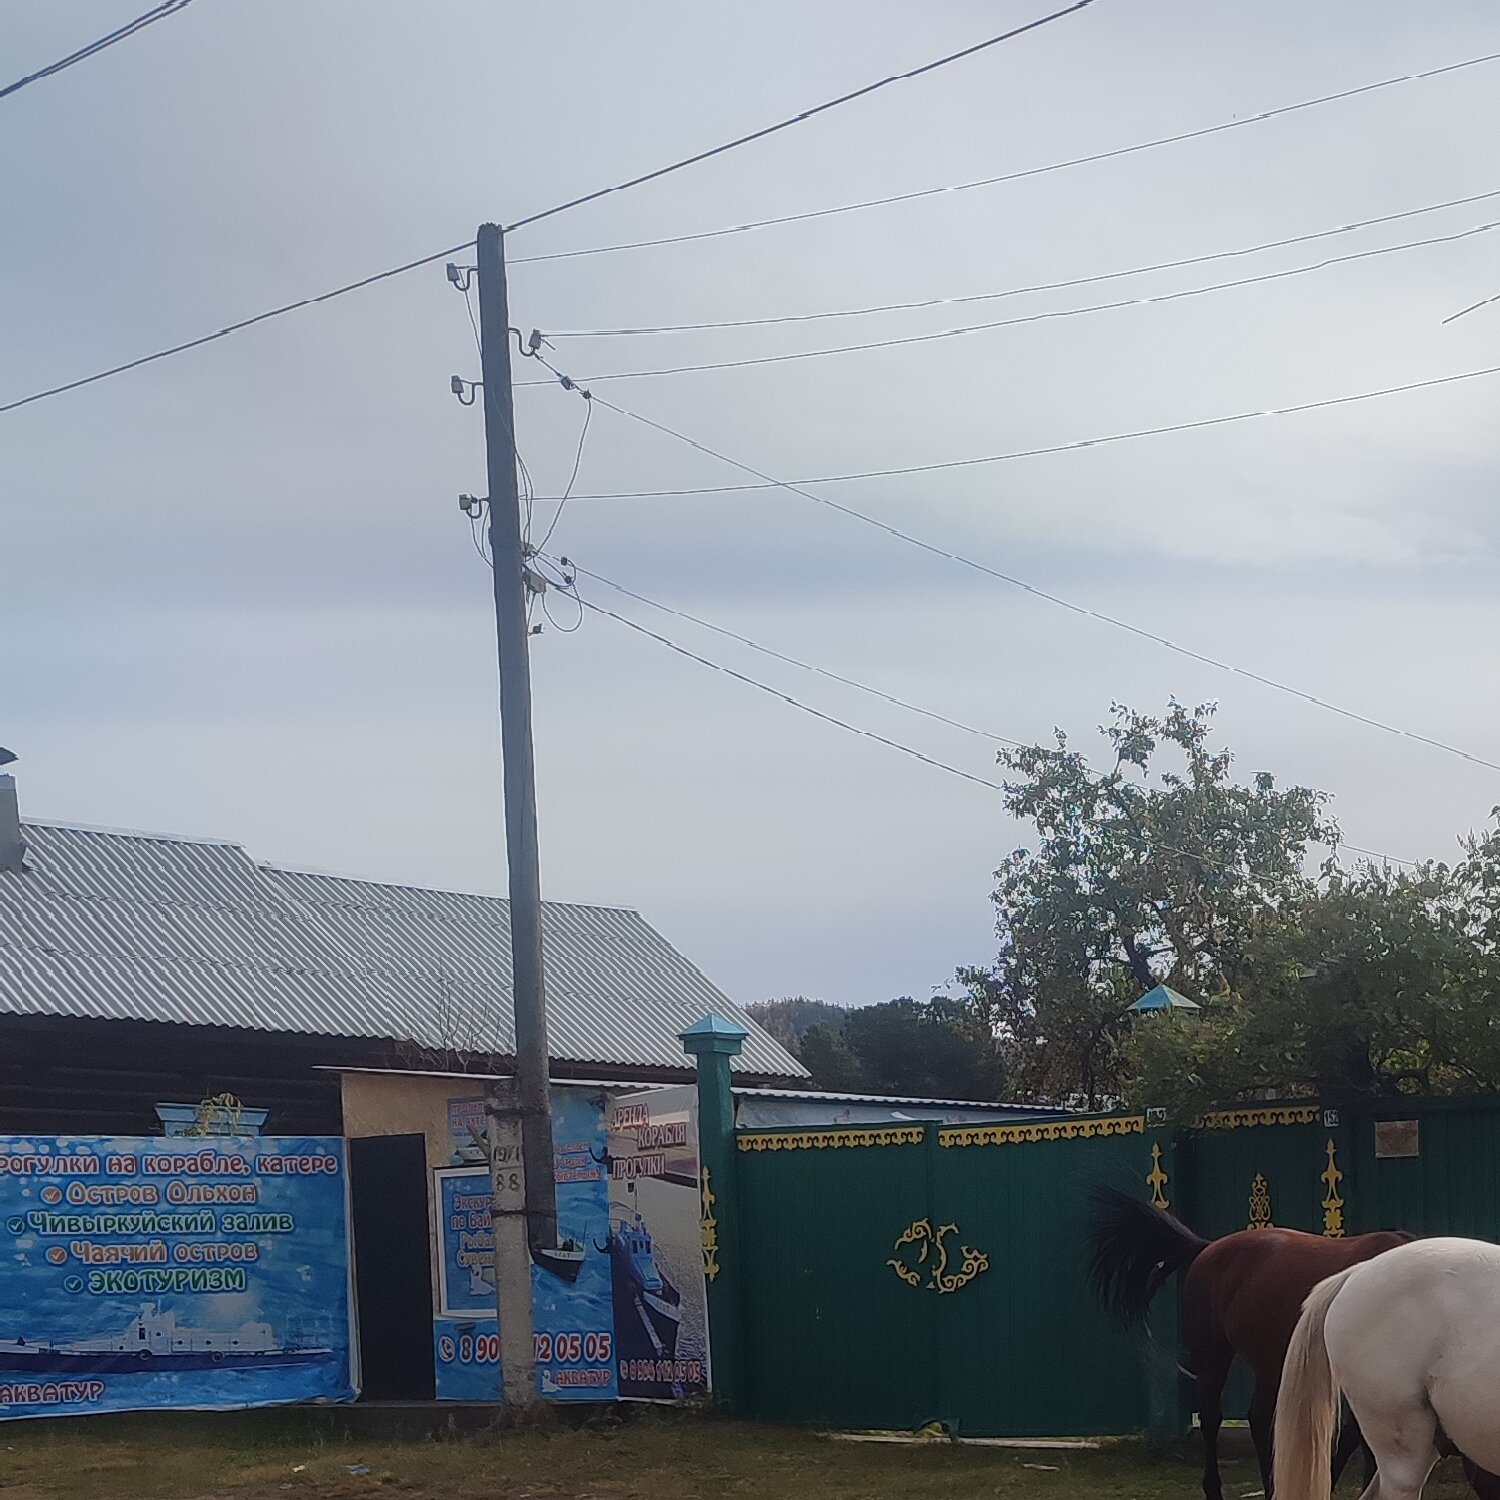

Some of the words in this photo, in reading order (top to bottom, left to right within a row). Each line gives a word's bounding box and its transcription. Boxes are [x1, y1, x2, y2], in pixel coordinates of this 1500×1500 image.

[637, 1122, 688, 1150] КОРАБЛЯ
[0, 1154, 98, 1174] рогулки
[107, 1155, 136, 1174] на
[142, 1151, 250, 1174] корабле,
[256, 1155, 337, 1174] катере
[612, 1153, 666, 1179] ПРОГУЛКИ
[66, 1181, 159, 1204] Остров
[166, 1181, 257, 1204] Ольхон
[453, 1193, 493, 1211] Экскур
[28, 1210, 215, 1234] Чивыркуйский
[222, 1213, 293, 1232] залив
[451, 1215, 466, 1230] по
[468, 1210, 493, 1229] бай
[72, 1240, 167, 1263] Чаячий
[174, 1243, 258, 1262] остров
[88, 1268, 246, 1293] ЭКОТУРИЗМ
[460, 1335, 473, 1362] 8
[475, 1334, 500, 1362] 90
[555, 1333, 581, 1362] 05
[583, 1333, 611, 1362] 05
[555, 1369, 611, 1388] АКВАТУР
[629, 1359, 637, 1380] 8
[674, 1360, 687, 1382] 05
[687, 1360, 701, 1383] 05
[0, 1381, 104, 1405] АКВАТУР
